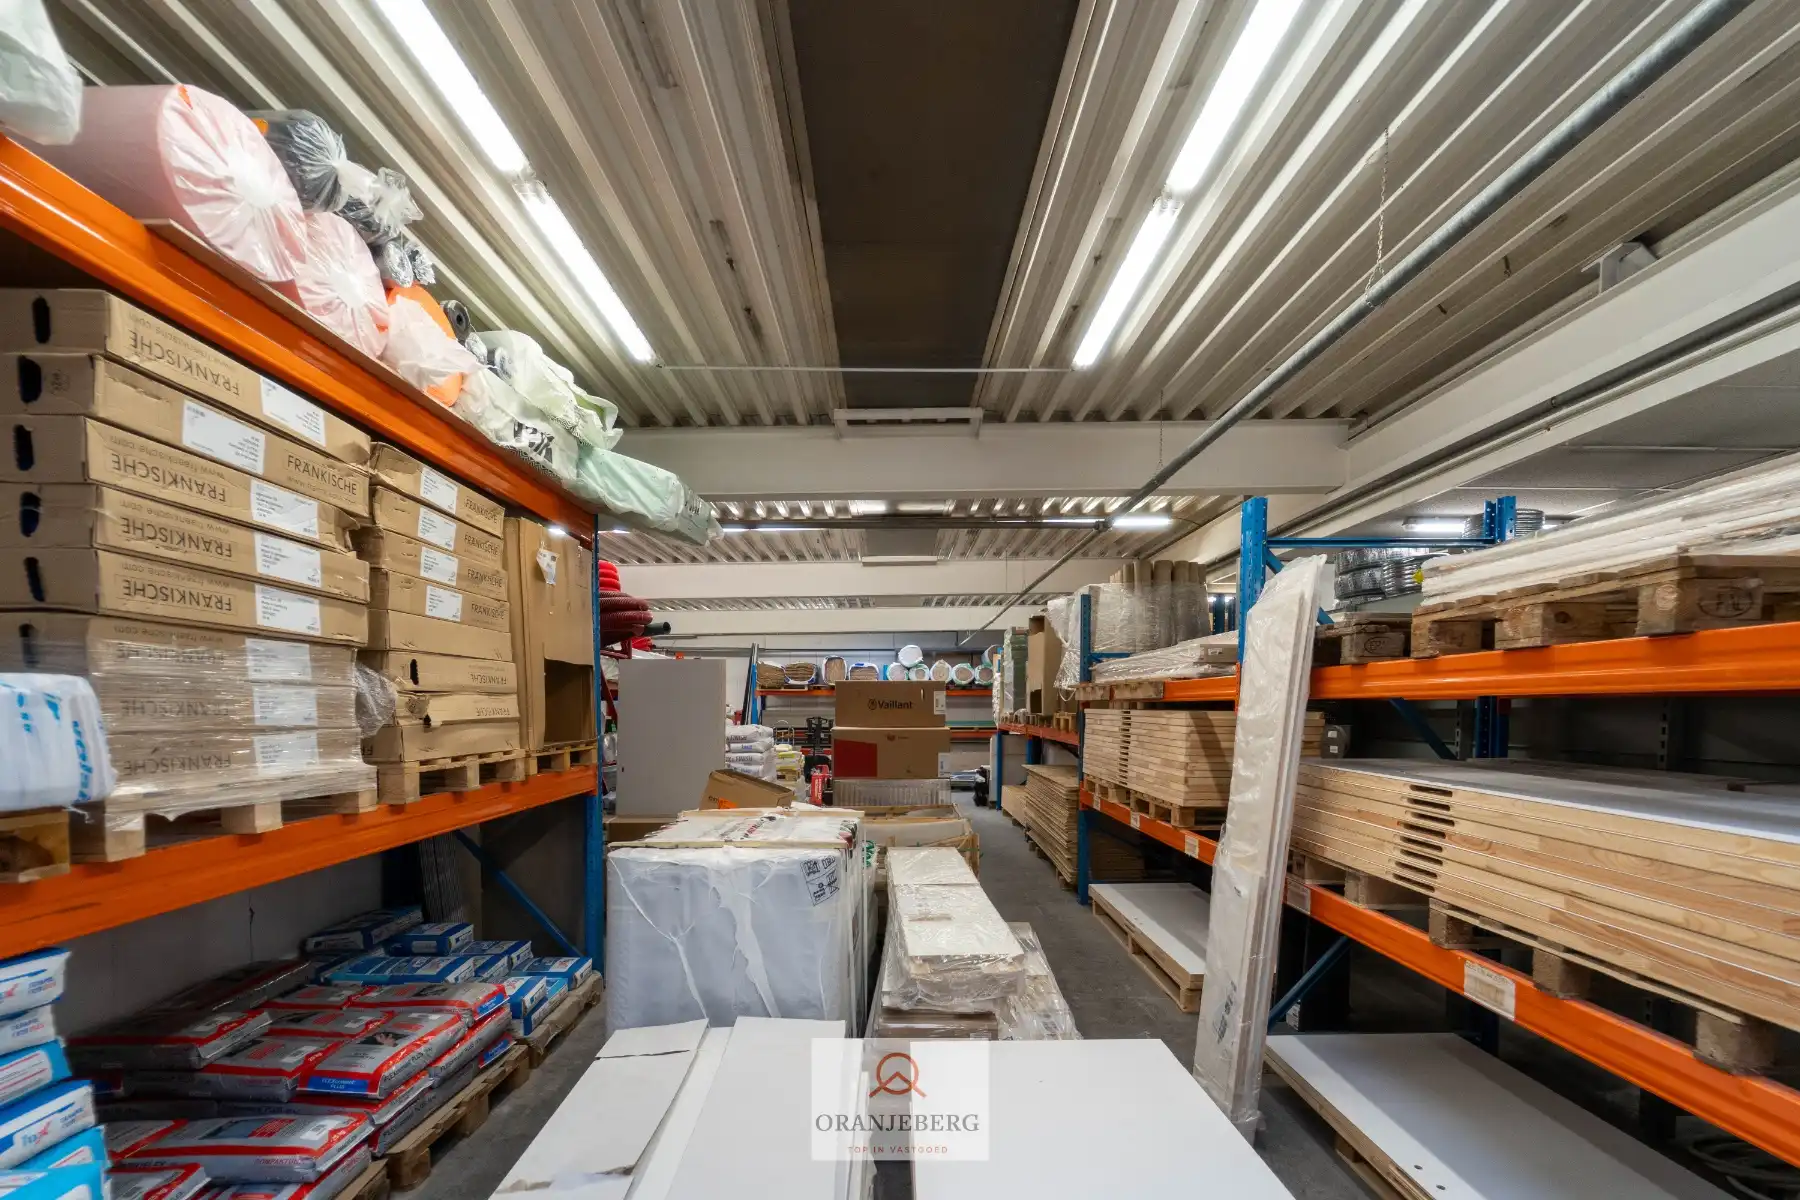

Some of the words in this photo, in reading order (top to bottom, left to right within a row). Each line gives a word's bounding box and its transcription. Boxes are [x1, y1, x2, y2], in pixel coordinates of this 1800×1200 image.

[129, 329, 240, 397] FRÄNKISCHE
[111, 453, 226, 502] FRÄNKISCHE
[287, 454, 357, 496] FRÄNKISCHE
[121, 517, 233, 557] FRÄNKISCHE
[122, 579, 233, 611] FRÄNKISCHE
[878, 700, 913, 709] Vaillant
